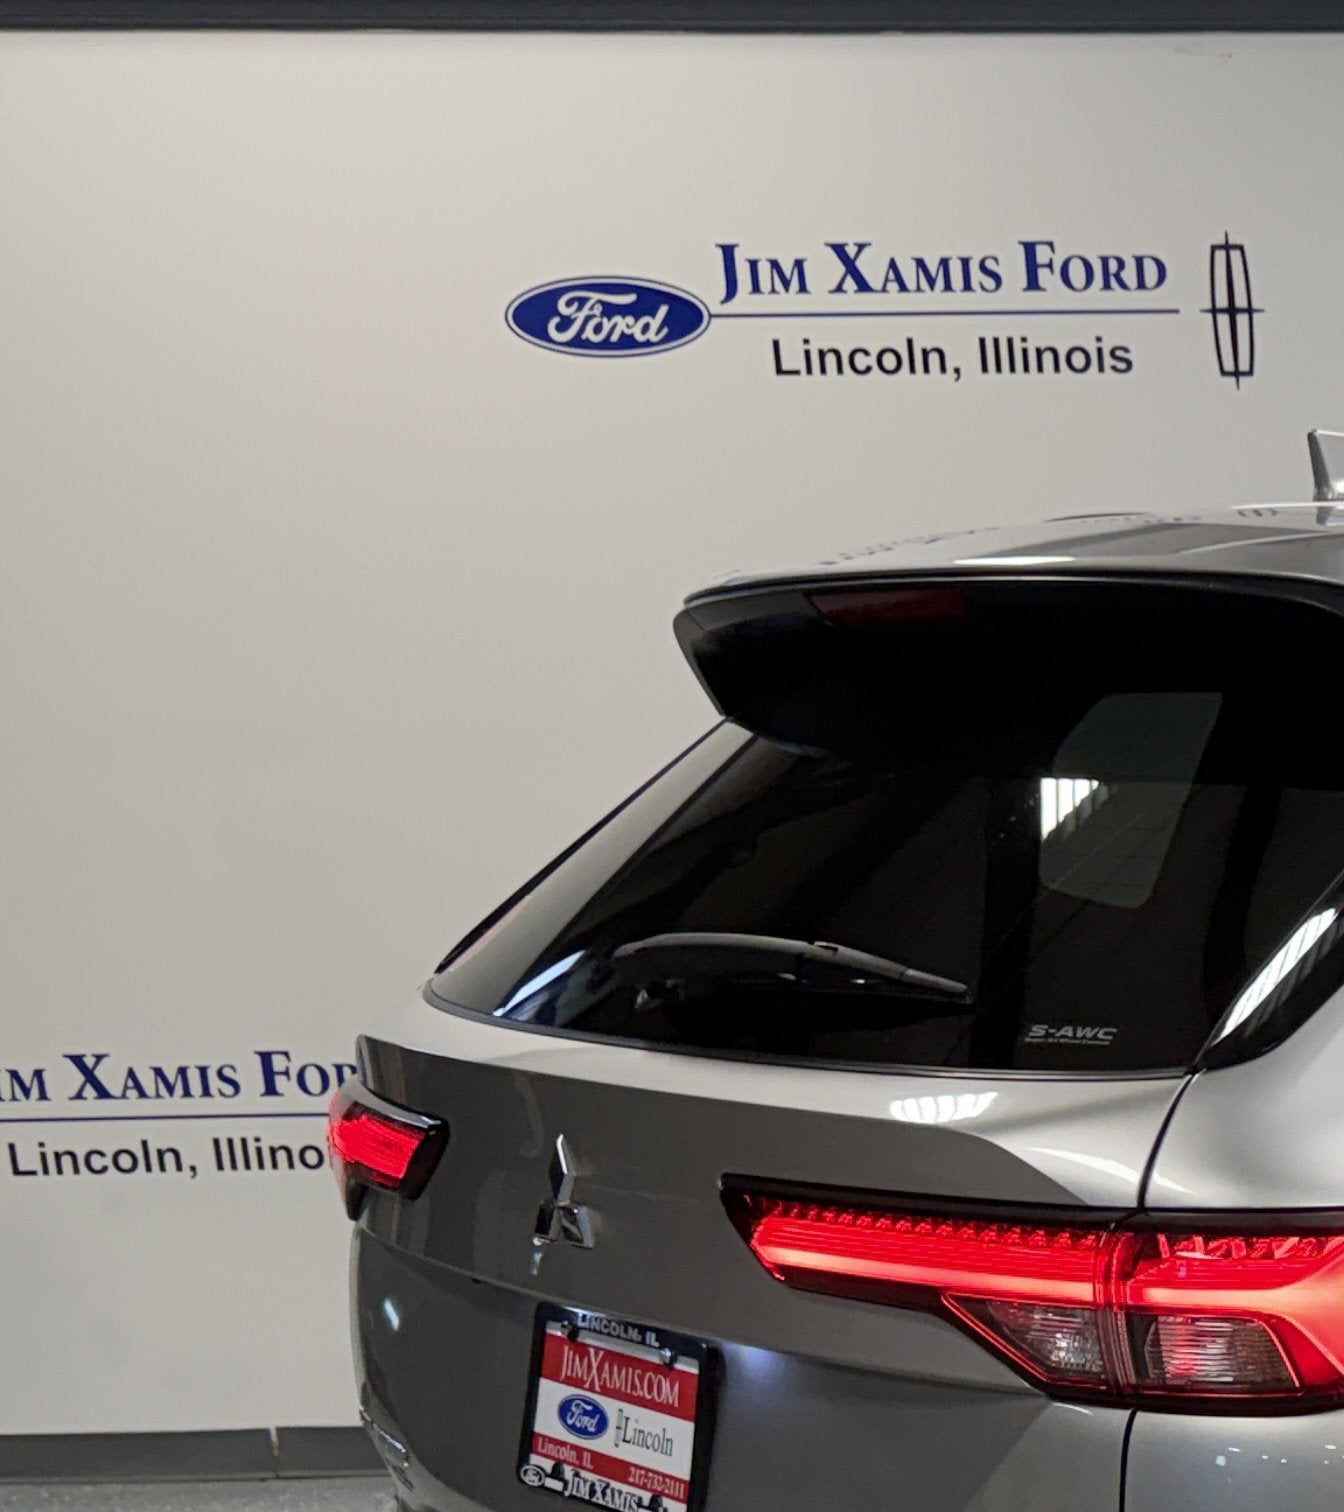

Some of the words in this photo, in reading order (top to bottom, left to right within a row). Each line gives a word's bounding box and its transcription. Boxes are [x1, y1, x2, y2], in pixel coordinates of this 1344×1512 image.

[715, 242, 810, 304] JIM
[824, 241, 1003, 294] XAMIS
[1018, 240, 1167, 292] FORD
[772, 337, 962, 382] Lincoln,
[978, 335, 1133, 374] Illinois
[1028, 1024, 1118, 1040] S-AWC
[62, 1053, 241, 1102] XAMIS
[7, 1138, 198, 1179] Lincoln,
[212, 1135, 333, 1172] Illino
[560, 1345, 679, 1408] JIMXAMIS.COM
[622, 1416, 674, 1457] Lincoln
[563, 1471, 590, 1500] JIM
